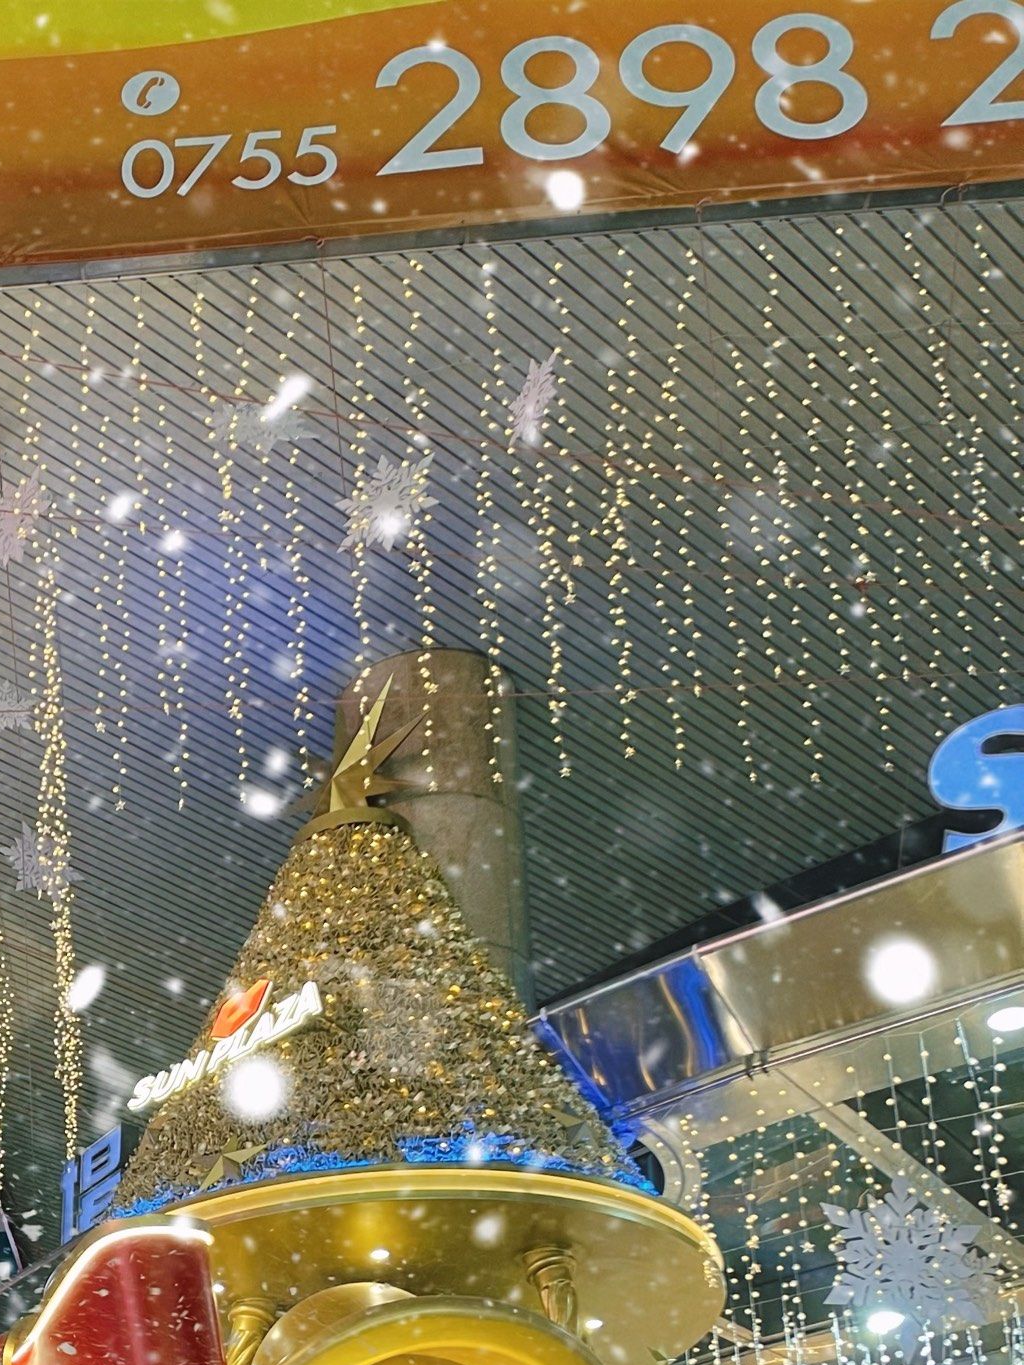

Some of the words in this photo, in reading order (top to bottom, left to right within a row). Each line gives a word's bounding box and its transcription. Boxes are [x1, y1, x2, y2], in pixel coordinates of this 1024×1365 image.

[121, 124, 337, 199] 0755
[376, 12, 869, 177] 2898
[127, 1049, 209, 1111] SUN
[207, 981, 323, 1073] PLAZA
